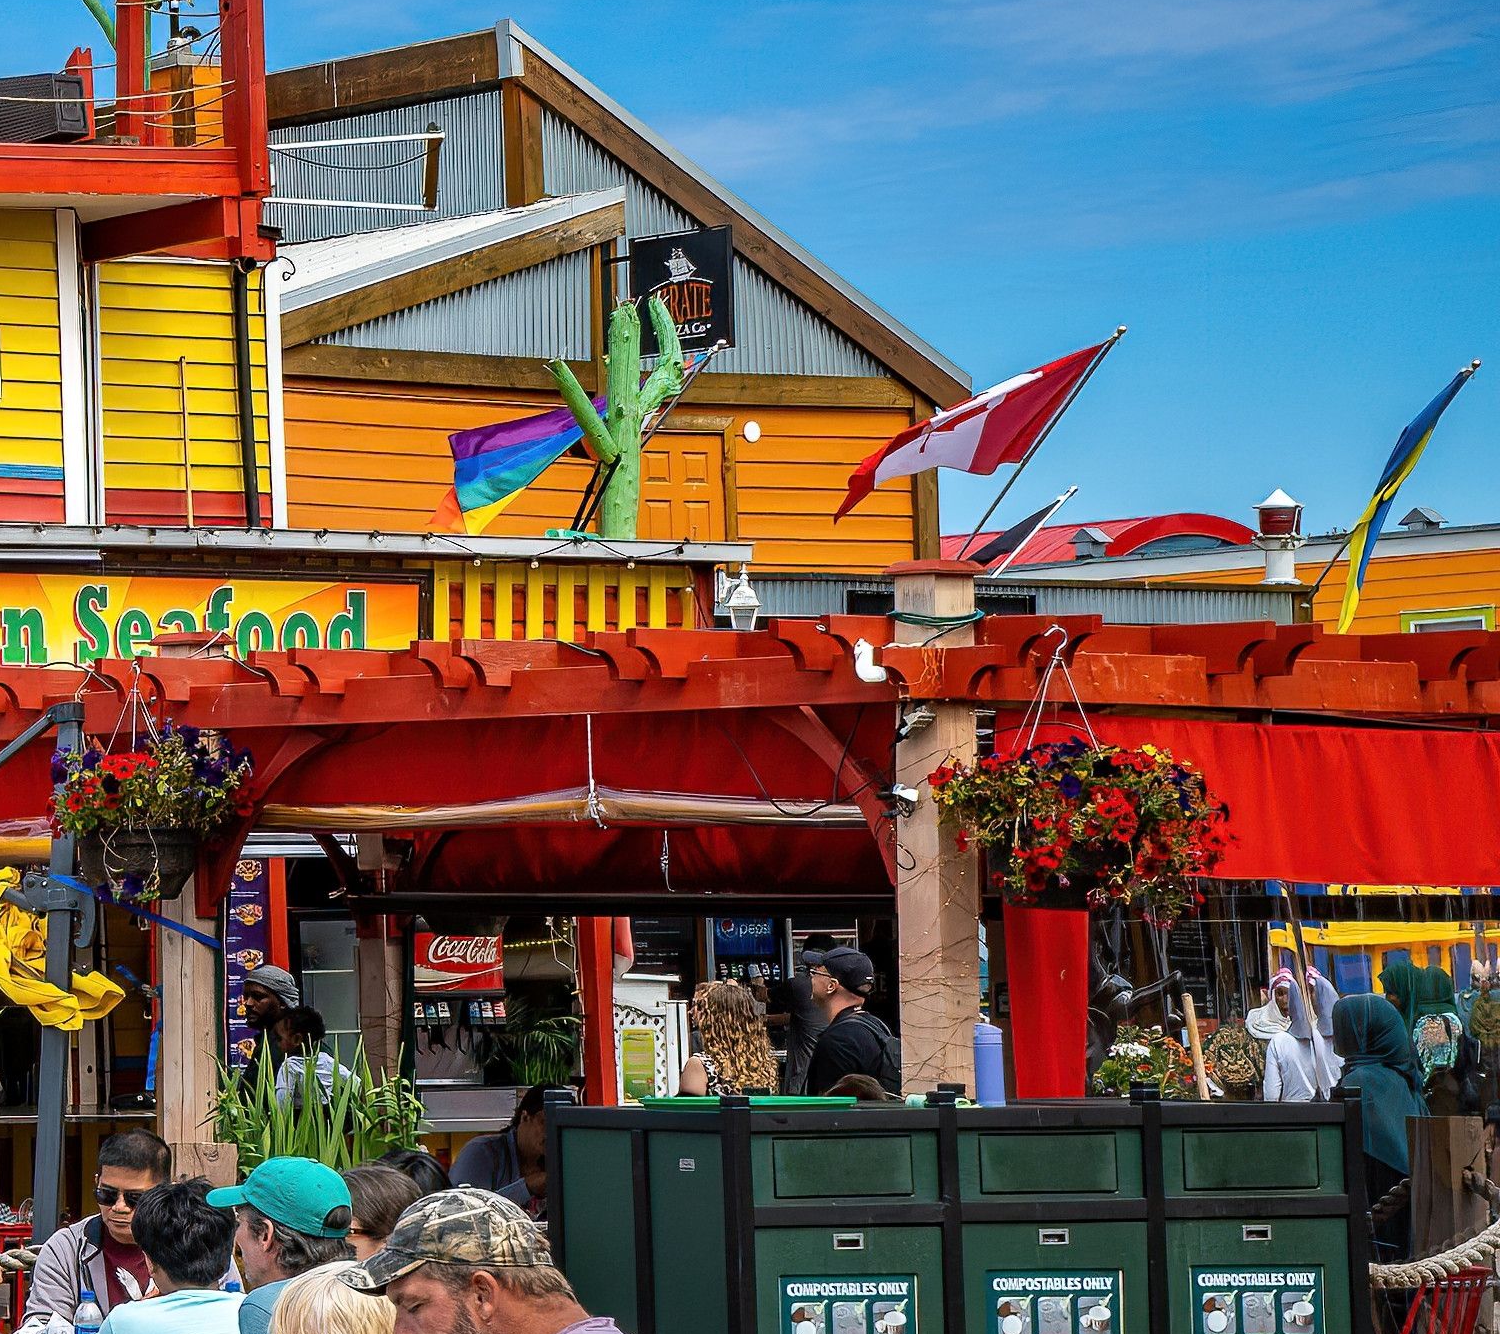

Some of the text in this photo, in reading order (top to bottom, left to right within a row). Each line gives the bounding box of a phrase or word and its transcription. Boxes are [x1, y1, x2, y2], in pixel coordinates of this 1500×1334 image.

[661, 282, 713, 323] RATE
[993, 1277, 1113, 1291] COMPOSTABLES ONLY
[1198, 1271, 1315, 1287] COMPOSTABLES ONLY
[786, 1281, 909, 1296] COMPOSTABLES ONLY
